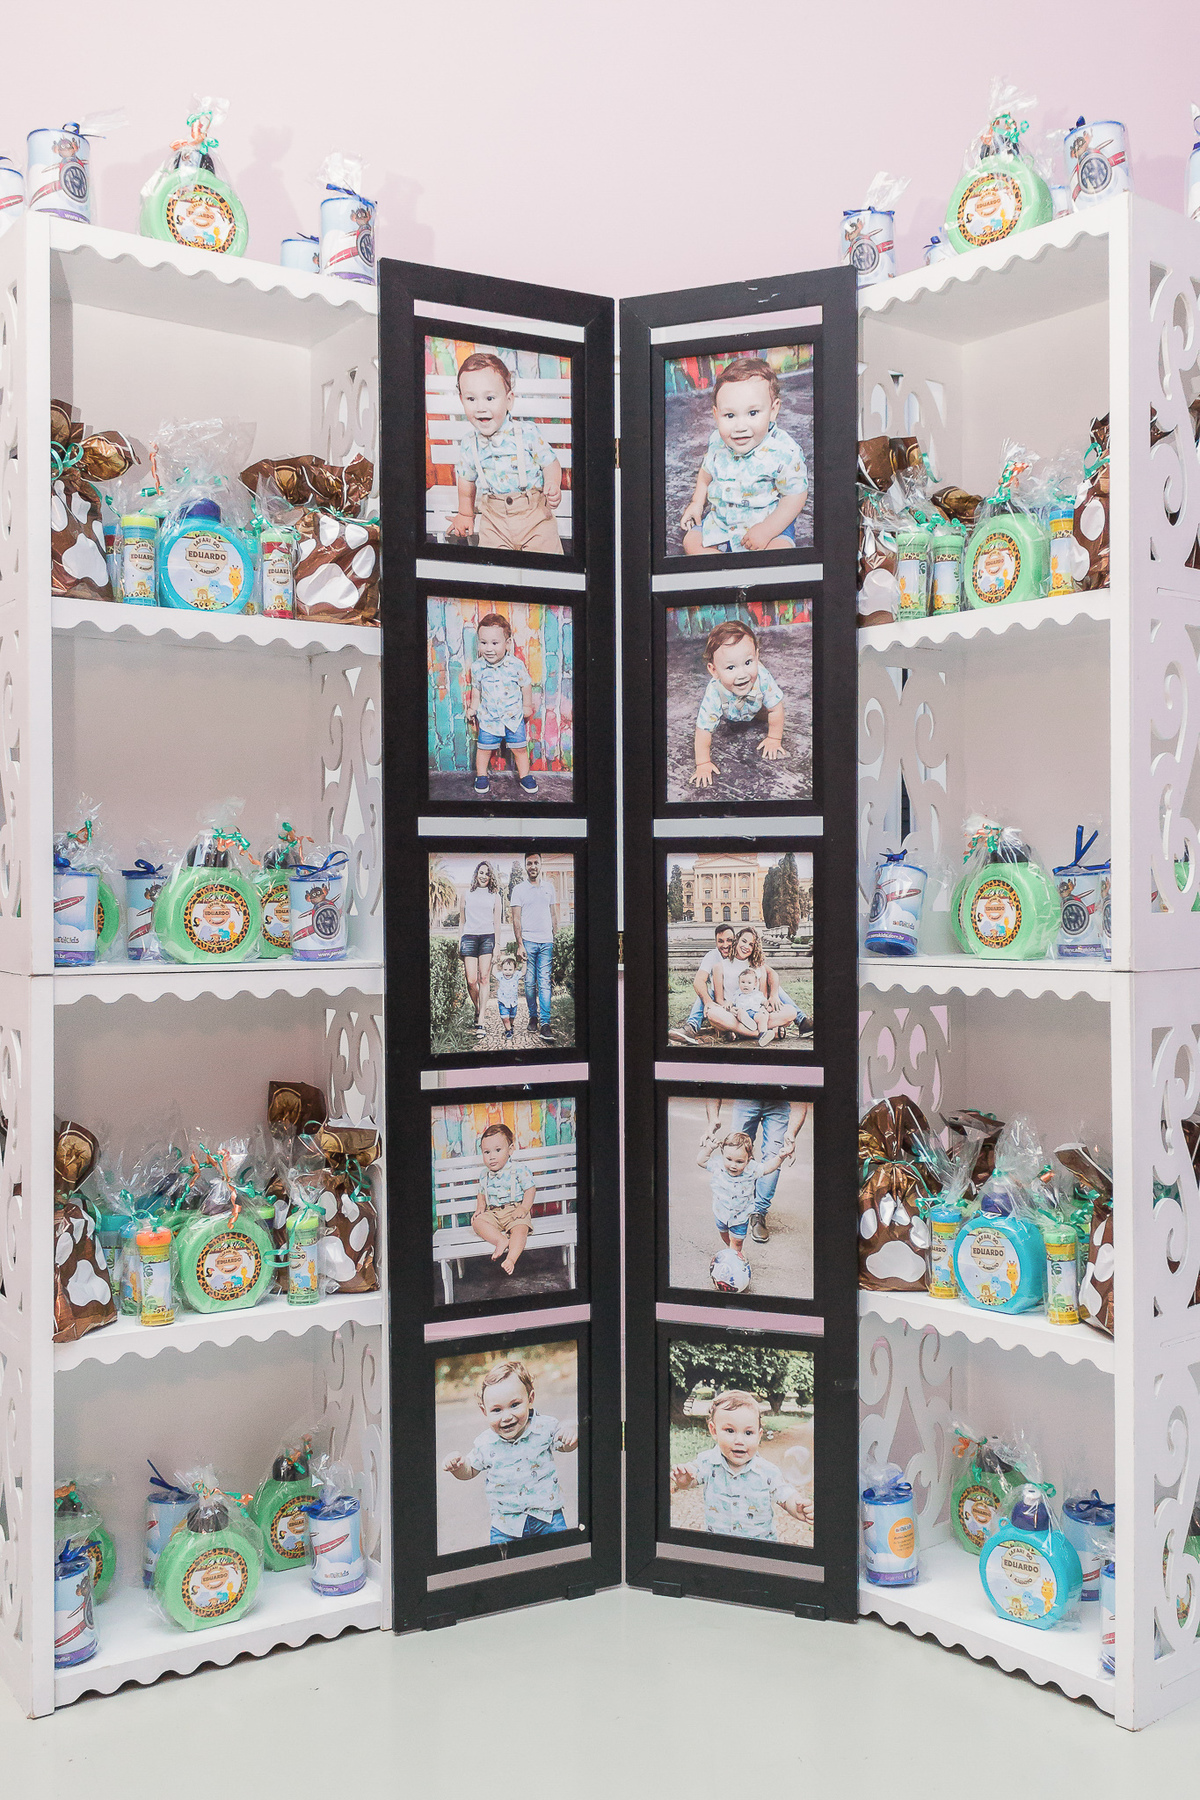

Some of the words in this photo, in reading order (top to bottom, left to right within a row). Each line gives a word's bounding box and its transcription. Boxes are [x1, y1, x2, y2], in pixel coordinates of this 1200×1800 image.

[188, 550, 227, 561] EDUARDO
[972, 1247, 1004, 1257] EDUARDO
[216, 1257, 242, 1266] EDUARDO
[1003, 1559, 1039, 1573] EDUARDO
[202, 1572, 229, 1582] EDUARDO
